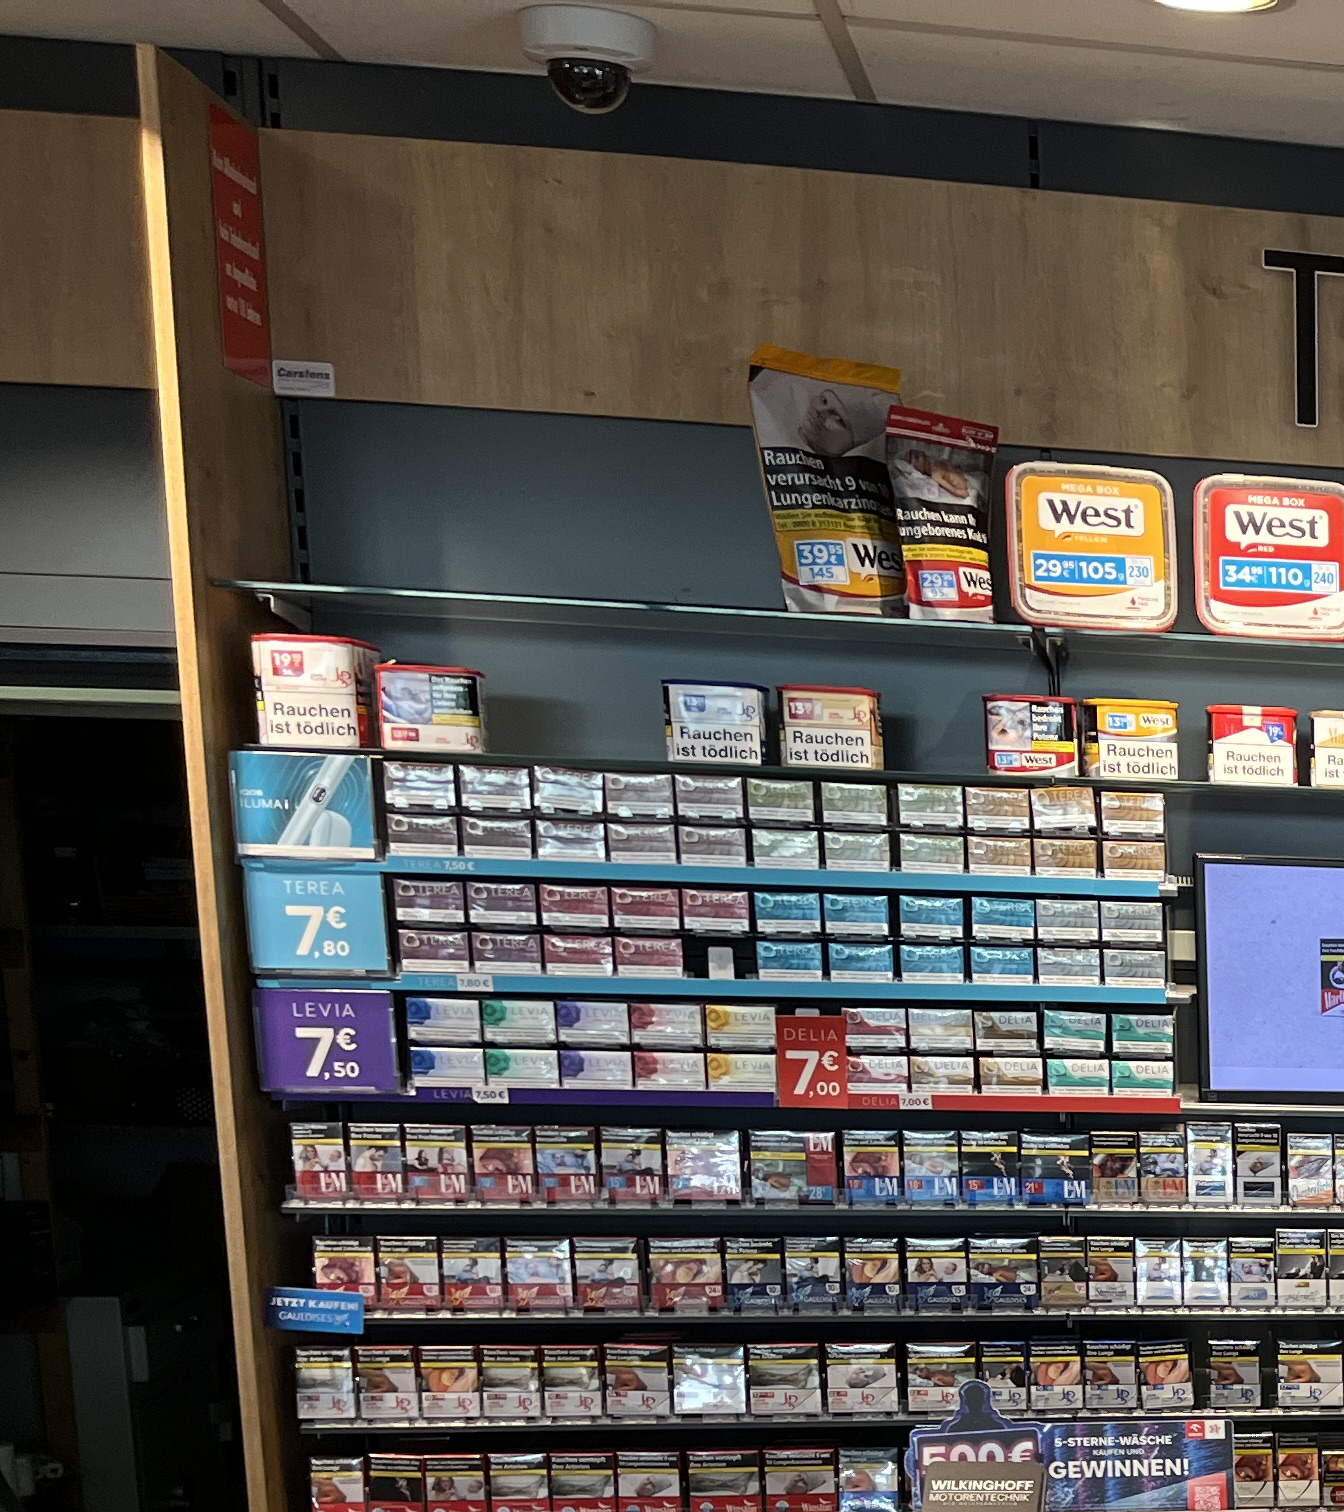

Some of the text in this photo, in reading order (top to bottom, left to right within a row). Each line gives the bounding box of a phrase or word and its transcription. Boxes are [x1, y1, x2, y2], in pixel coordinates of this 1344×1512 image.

[764, 449, 824, 470] Rauchen
[767, 472, 842, 490] verursacht
[1061, 482, 1120, 496] MEGA BOX
[1248, 494, 1306, 508] MEGA BOX
[1046, 498, 1135, 530] West
[1234, 510, 1319, 541] West
[1257, 545, 1275, 553] RED
[809, 567, 834, 580] 145
[1128, 564, 1149, 579] 230
[1314, 571, 1335, 586] 240
[273, 702, 352, 719] Rauchen
[269, 721, 358, 738] ist tödlich
[283, 880, 345, 895] TEREA
[292, 1002, 356, 1019] LEVIA
[783, 1026, 839, 1043] DELIA
[1054, 1434, 1173, 1448] 5-STERNE-WÄSCHE
[1092, 1448, 1145, 1456] KAUFEN UND
[1048, 1459, 1190, 1479] GEWINNEN!
[931, 1479, 1035, 1492] WILKINGHOFF
[929, 1492, 1031, 1503] MOTORENTECHNIK
